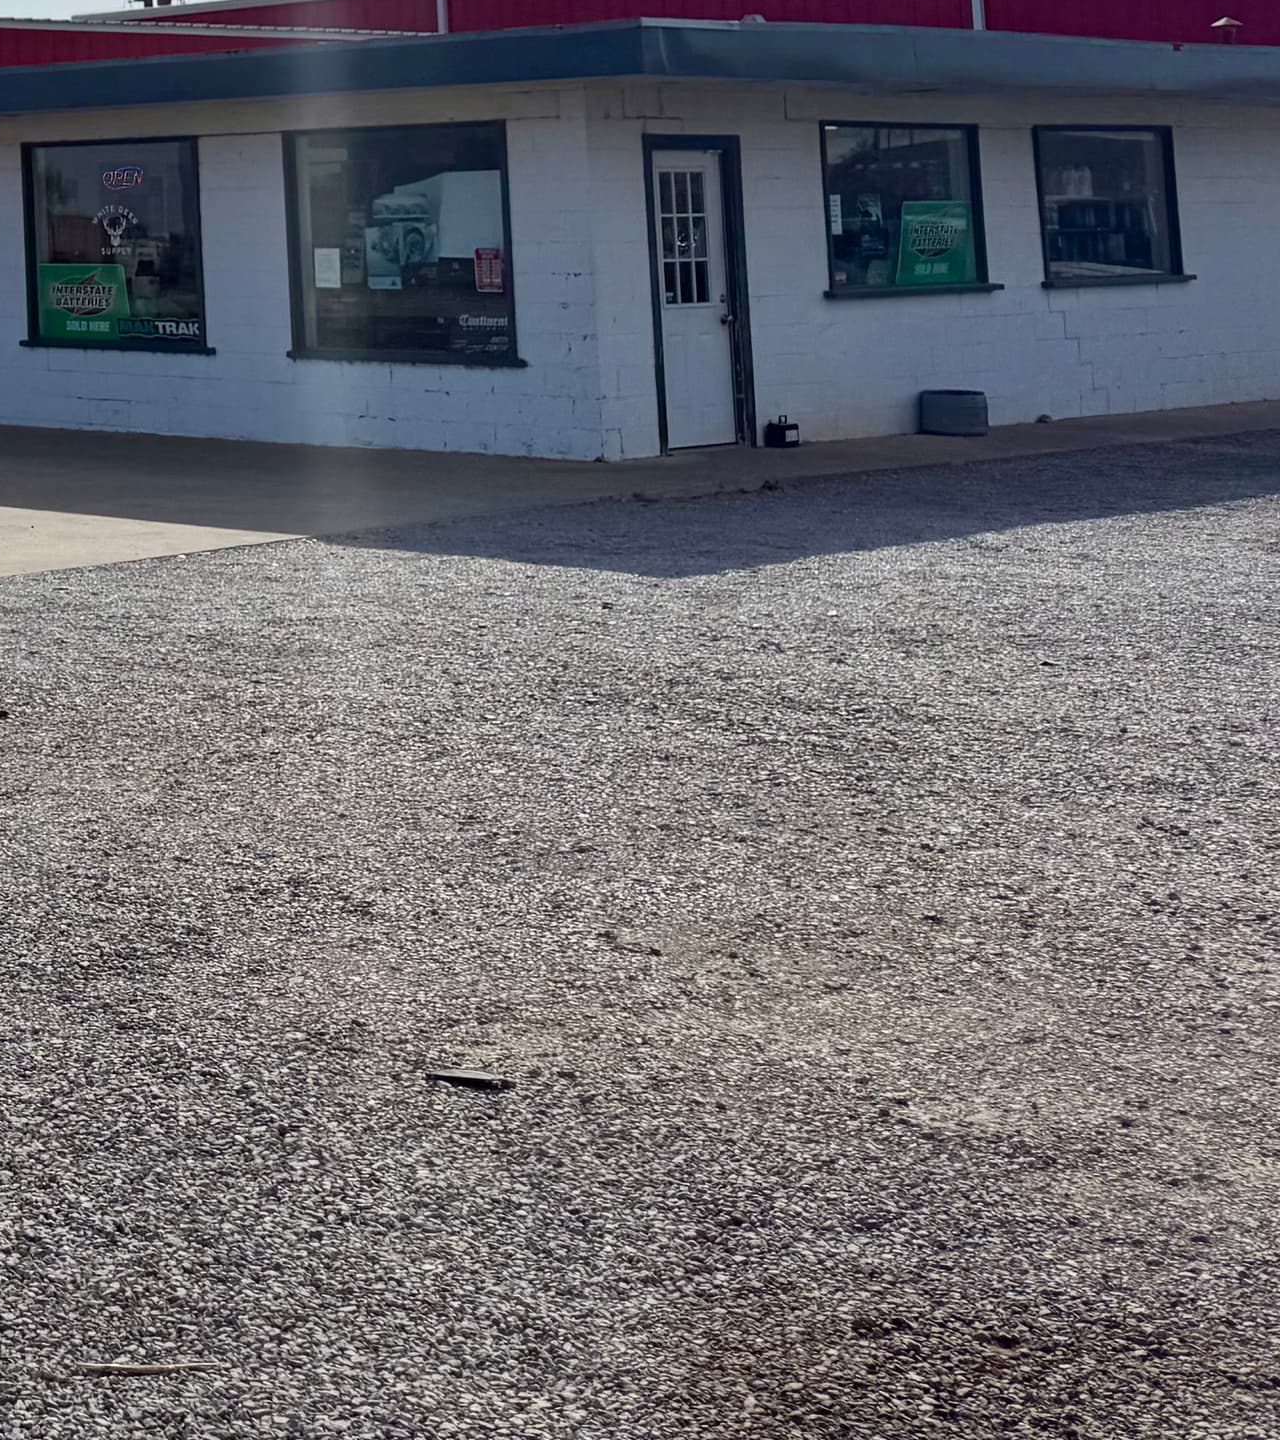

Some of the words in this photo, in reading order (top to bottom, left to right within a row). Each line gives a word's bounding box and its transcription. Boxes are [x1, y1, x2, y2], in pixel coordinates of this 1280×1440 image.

[102, 169, 143, 186] OPEN
[101, 247, 131, 256] SUPPLY
[52, 285, 113, 296] INTERSTATE
[55, 296, 111, 308] BATTERIES
[66, 320, 88, 332] SOLD
[88, 320, 111, 333] HERE
